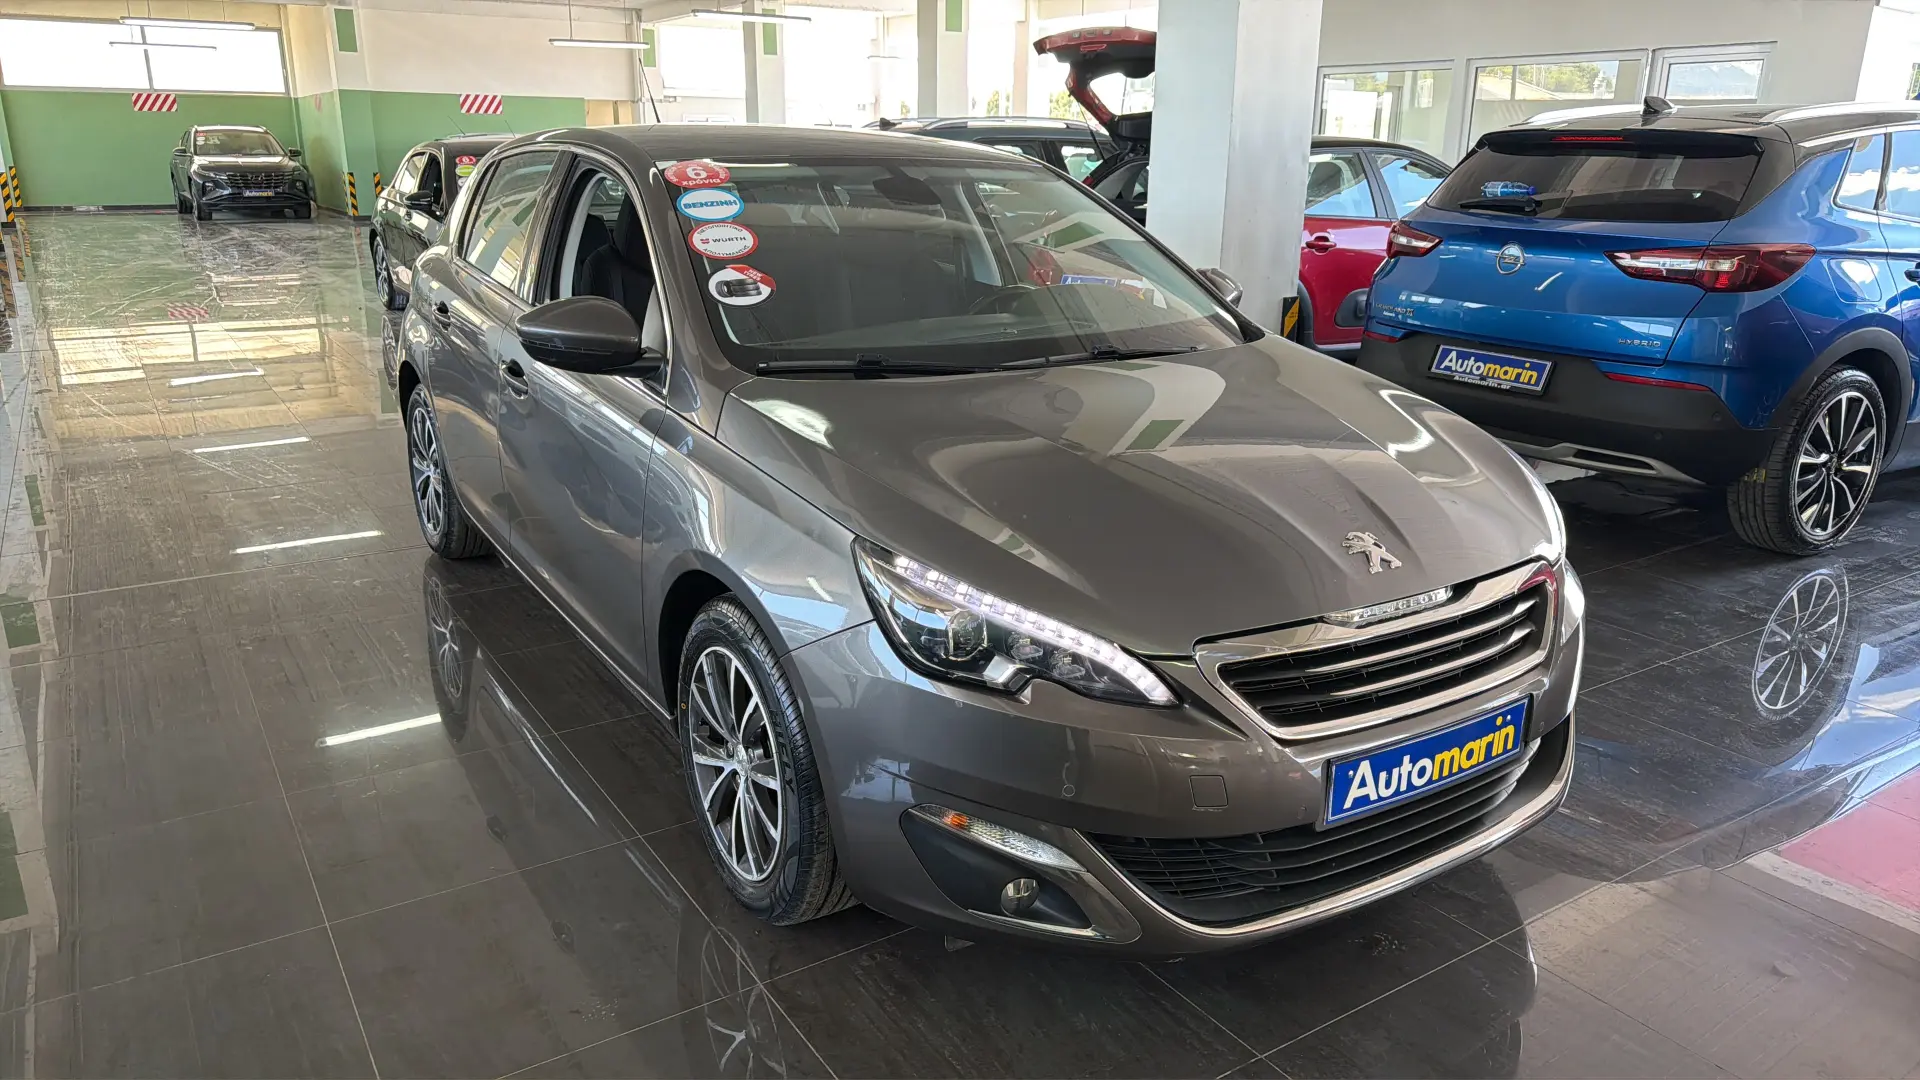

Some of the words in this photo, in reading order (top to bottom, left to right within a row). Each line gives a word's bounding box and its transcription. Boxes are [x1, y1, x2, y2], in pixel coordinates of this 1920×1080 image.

[686, 166, 707, 179] 6
[681, 178, 722, 187] χρόνια
[1618, 338, 1661, 347] HYBRID
[1440, 350, 1537, 384] Automarin
[1343, 716, 1515, 810] Automarin
